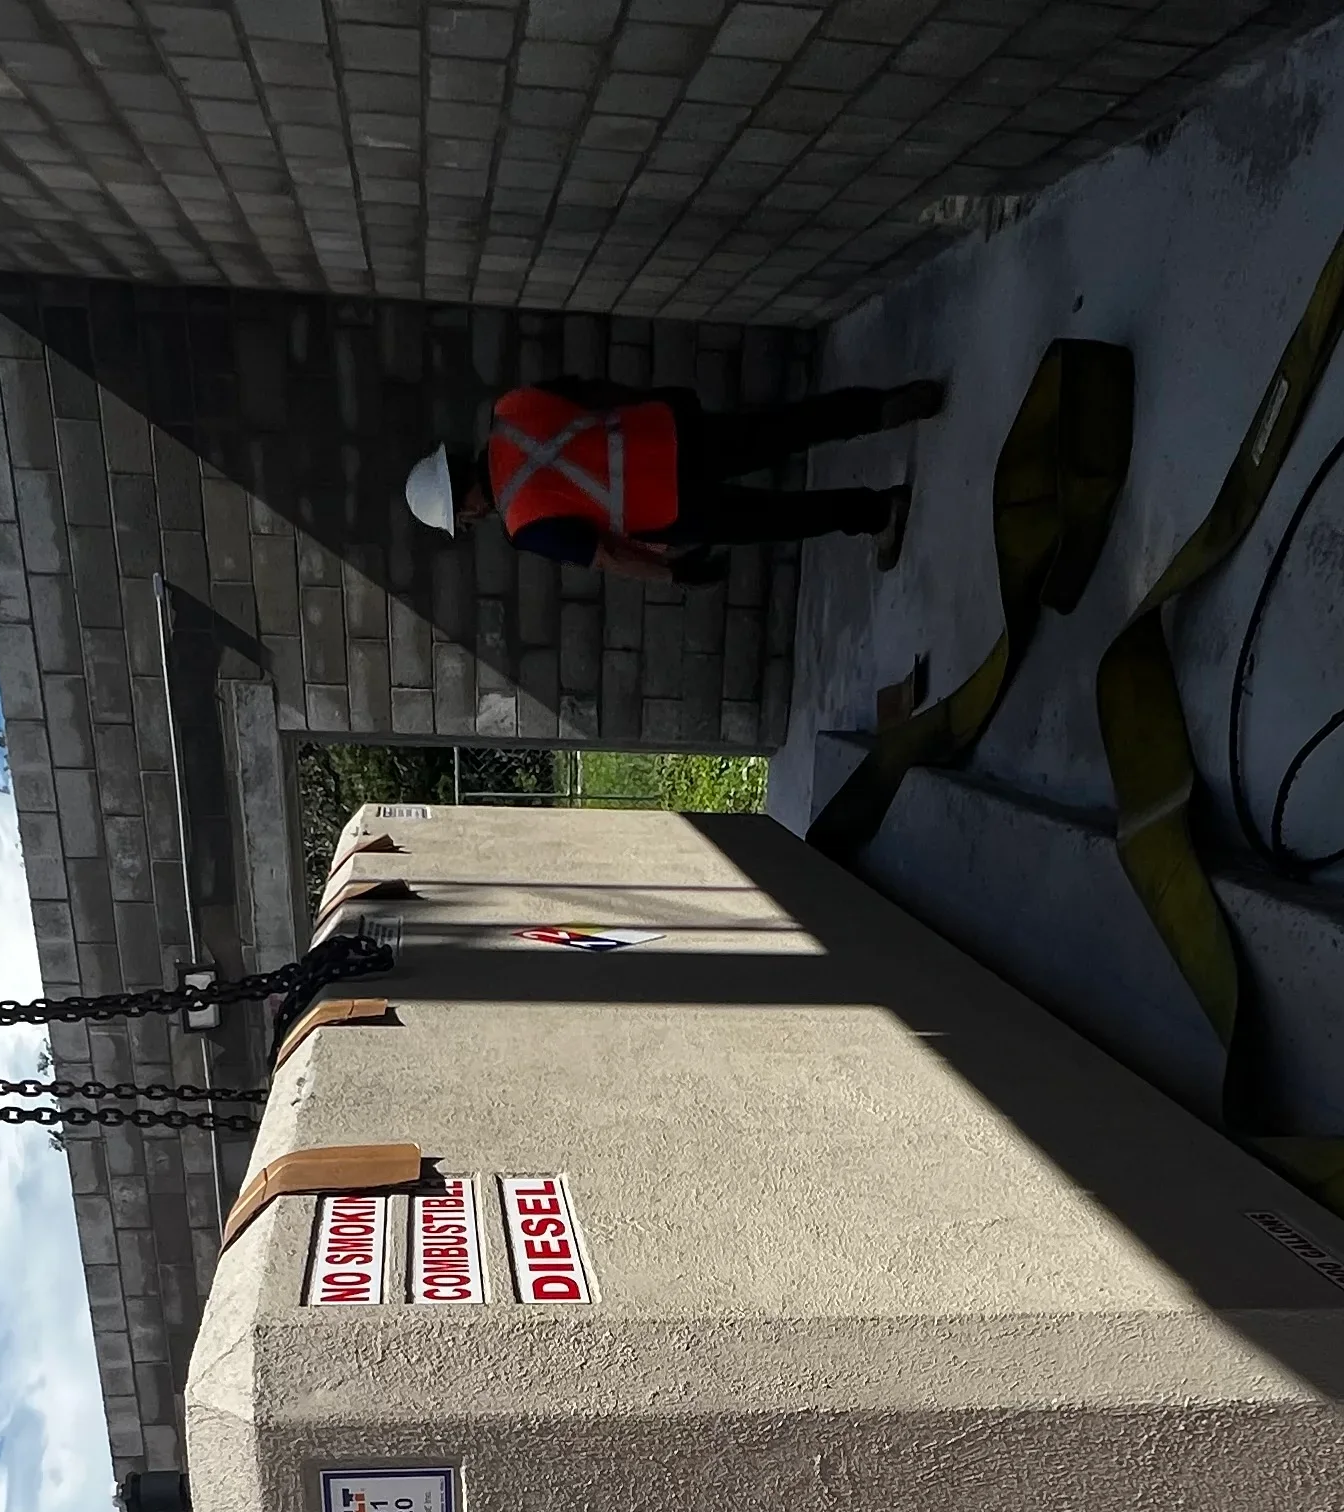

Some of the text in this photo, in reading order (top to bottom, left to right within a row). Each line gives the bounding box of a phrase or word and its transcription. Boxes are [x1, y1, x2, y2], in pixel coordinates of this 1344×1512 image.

[523, 930, 571, 940] 2
[514, 1180, 582, 1300] DIESEL
[1249, 1213, 1327, 1259] GALLONS
[320, 1272, 372, 1302] NO
